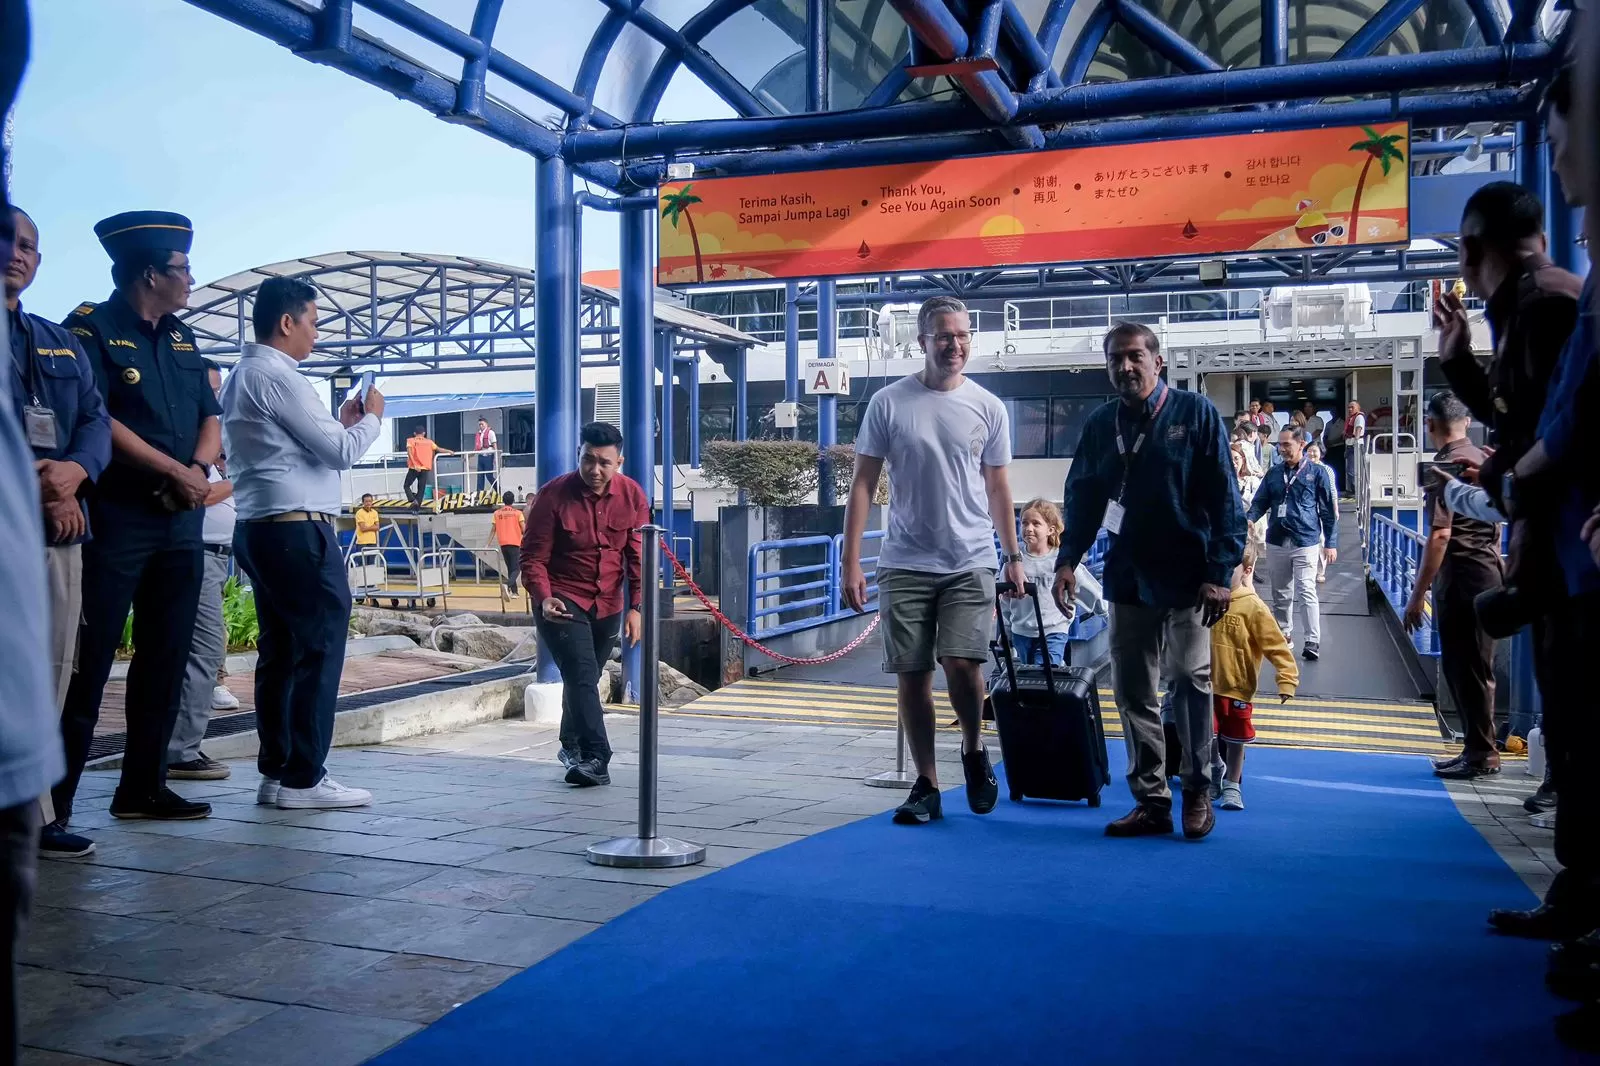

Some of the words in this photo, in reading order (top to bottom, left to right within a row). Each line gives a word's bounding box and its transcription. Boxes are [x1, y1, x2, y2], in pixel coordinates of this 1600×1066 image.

[1246, 157, 1266, 170] 감사
[1270, 155, 1301, 169] 합니다
[1094, 163, 1209, 182] ありがとうございます
[1246, 175, 1256, 187] 또
[1259, 173, 1290, 187] 만나요
[880, 184, 917, 198] Thank
[920, 184, 946, 196] You,
[1033, 190, 1058, 204] 再见
[1094, 186, 1139, 199] またぜひ
[739, 196, 777, 209] Terima
[780, 192, 816, 206] Kasih,
[880, 202, 902, 214] See
[905, 200, 926, 212] You
[930, 197, 966, 213] Again
[969, 195, 1000, 208] Soon
[739, 210, 781, 224] Sampai
[783, 209, 822, 222] Jumpa
[826, 205, 850, 220] Lagi
[813, 370, 830, 390] A
